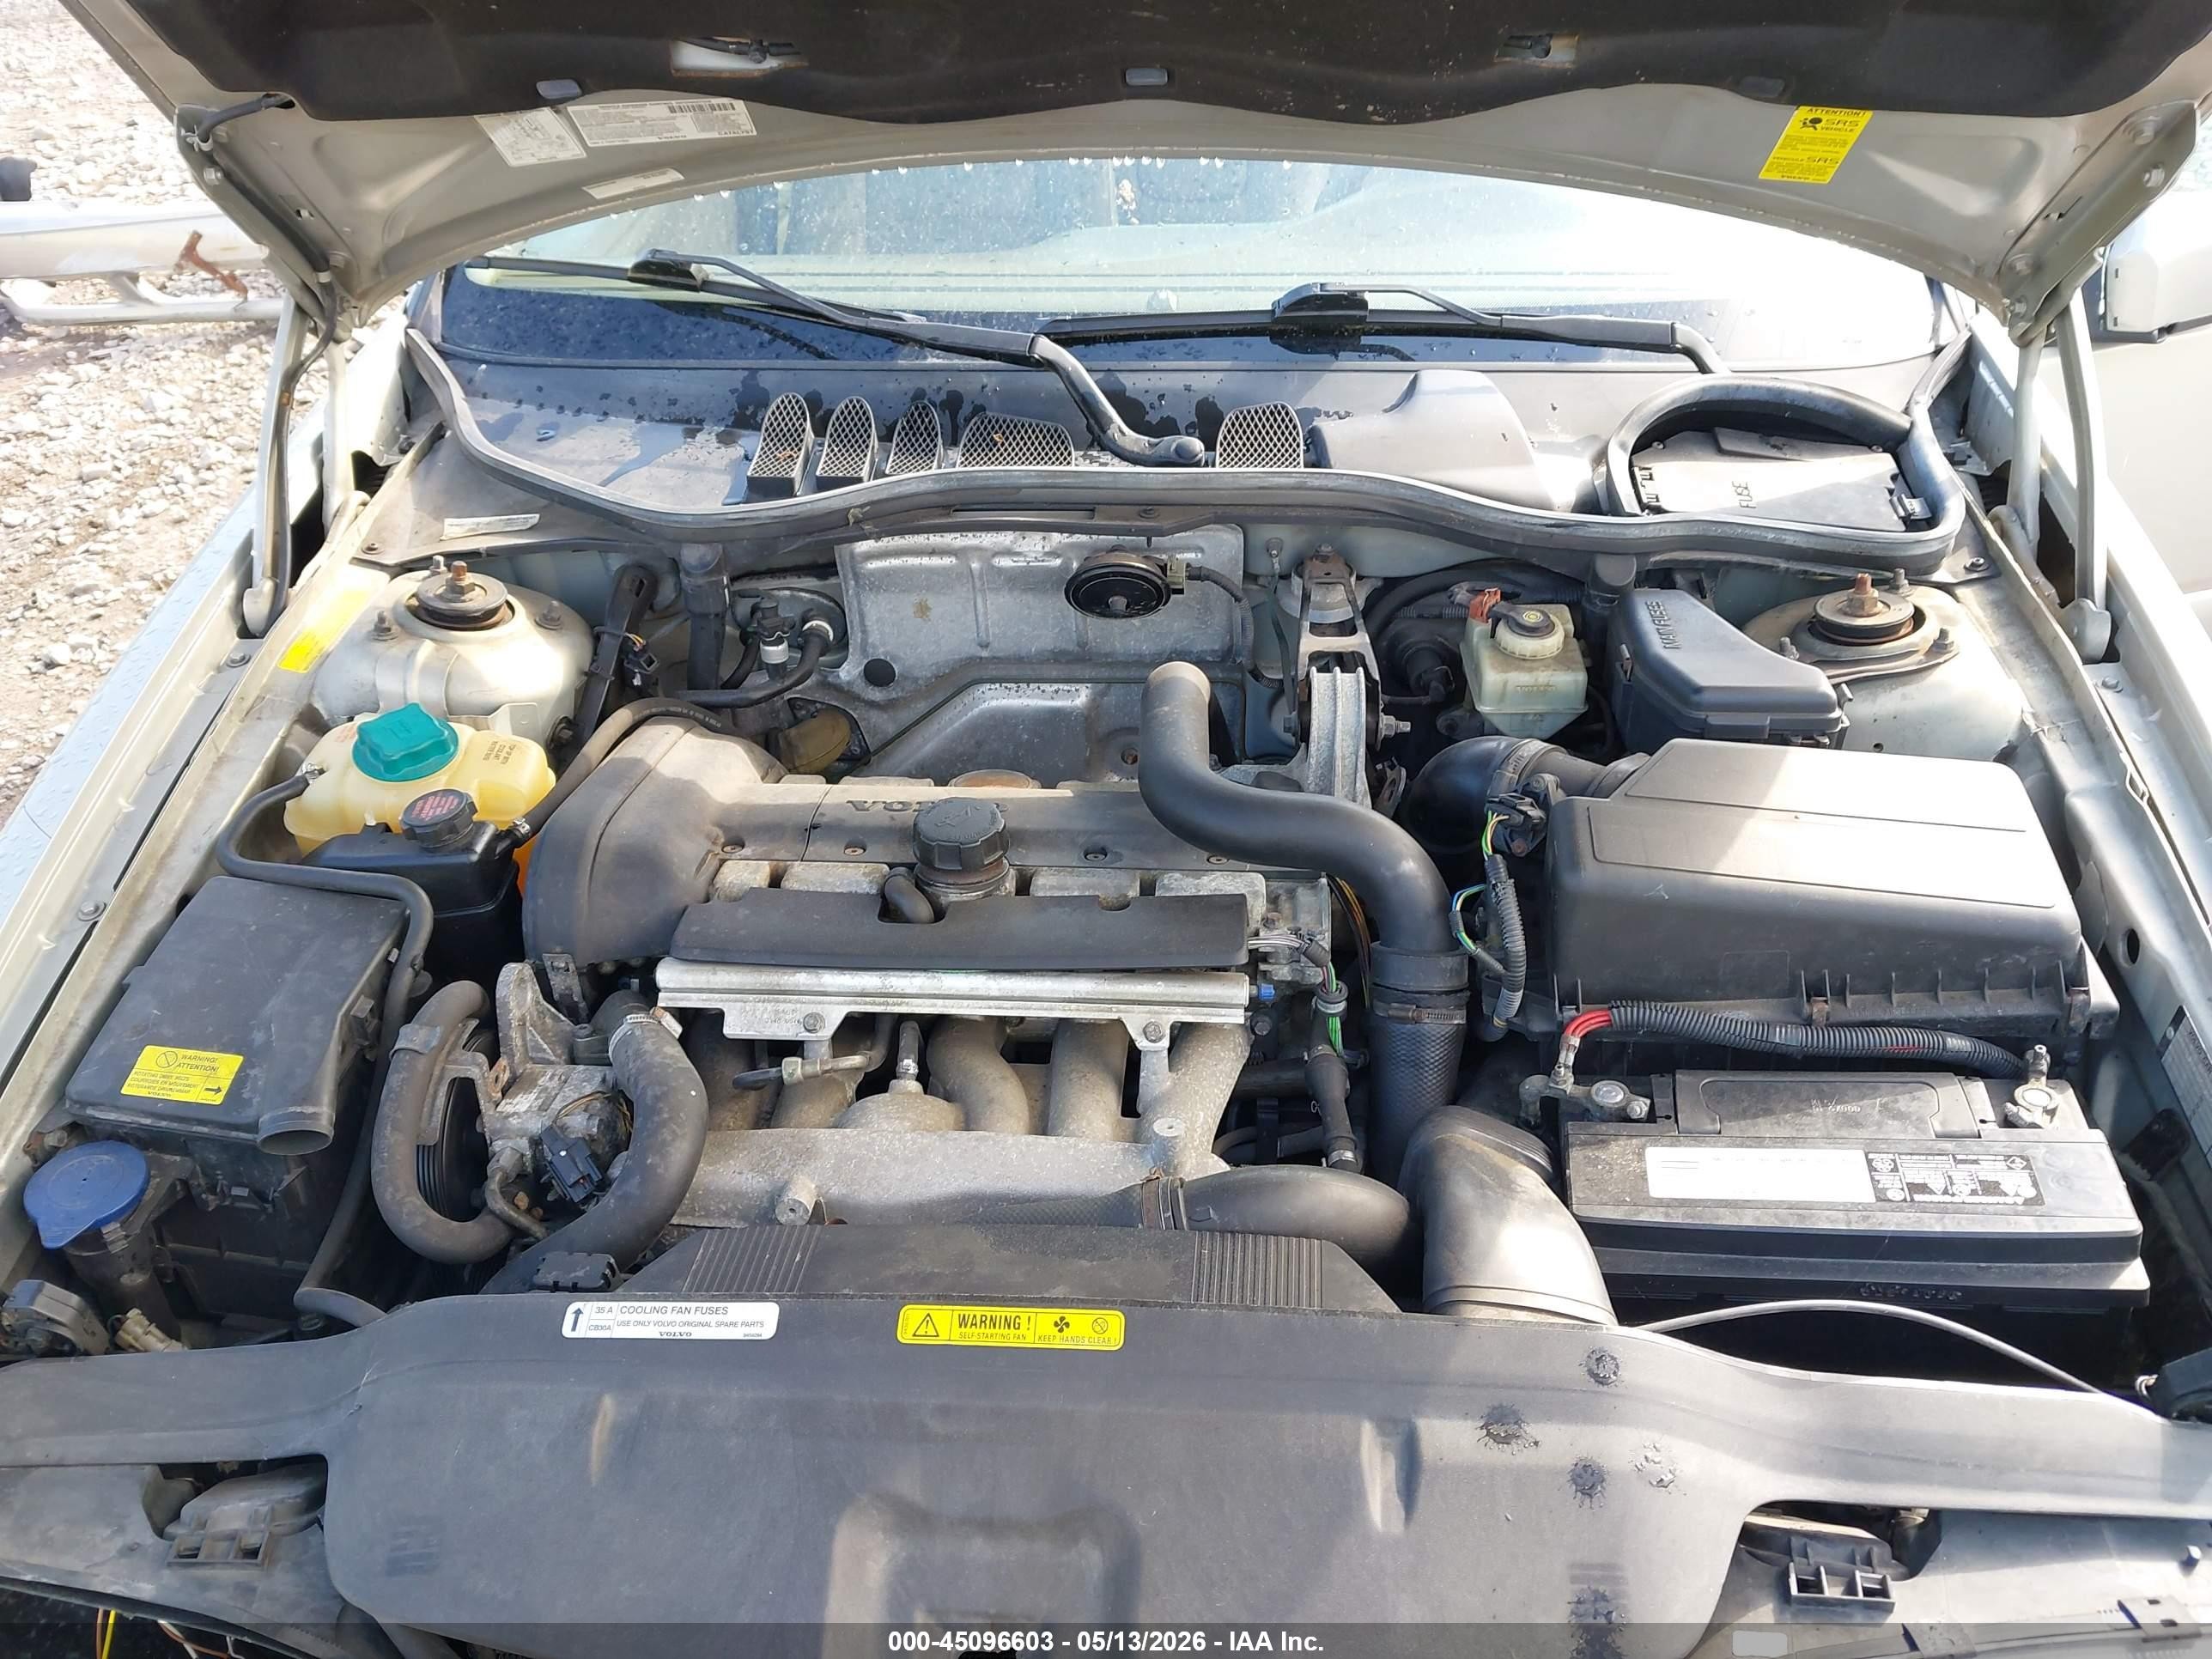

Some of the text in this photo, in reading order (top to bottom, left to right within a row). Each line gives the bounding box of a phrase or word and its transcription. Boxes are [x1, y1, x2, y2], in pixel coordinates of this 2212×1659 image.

[1826, 118, 1860, 127] SRS
[1732, 481, 1757, 509] FUSE
[1644, 600, 1683, 650] MAIN FUSES
[181, 1054, 217, 1063] WARNING!
[176, 1063, 219, 1072] ATTENTION!
[620, 1305, 729, 1316] COOLING FAN FUSES
[958, 1313, 1021, 1331] WARNING
[958, 1332, 1011, 1340] SELF-STARTING
[1060, 1335, 1085, 1344] HANDS
[1087, 1336, 1111, 1345] CLEAR
